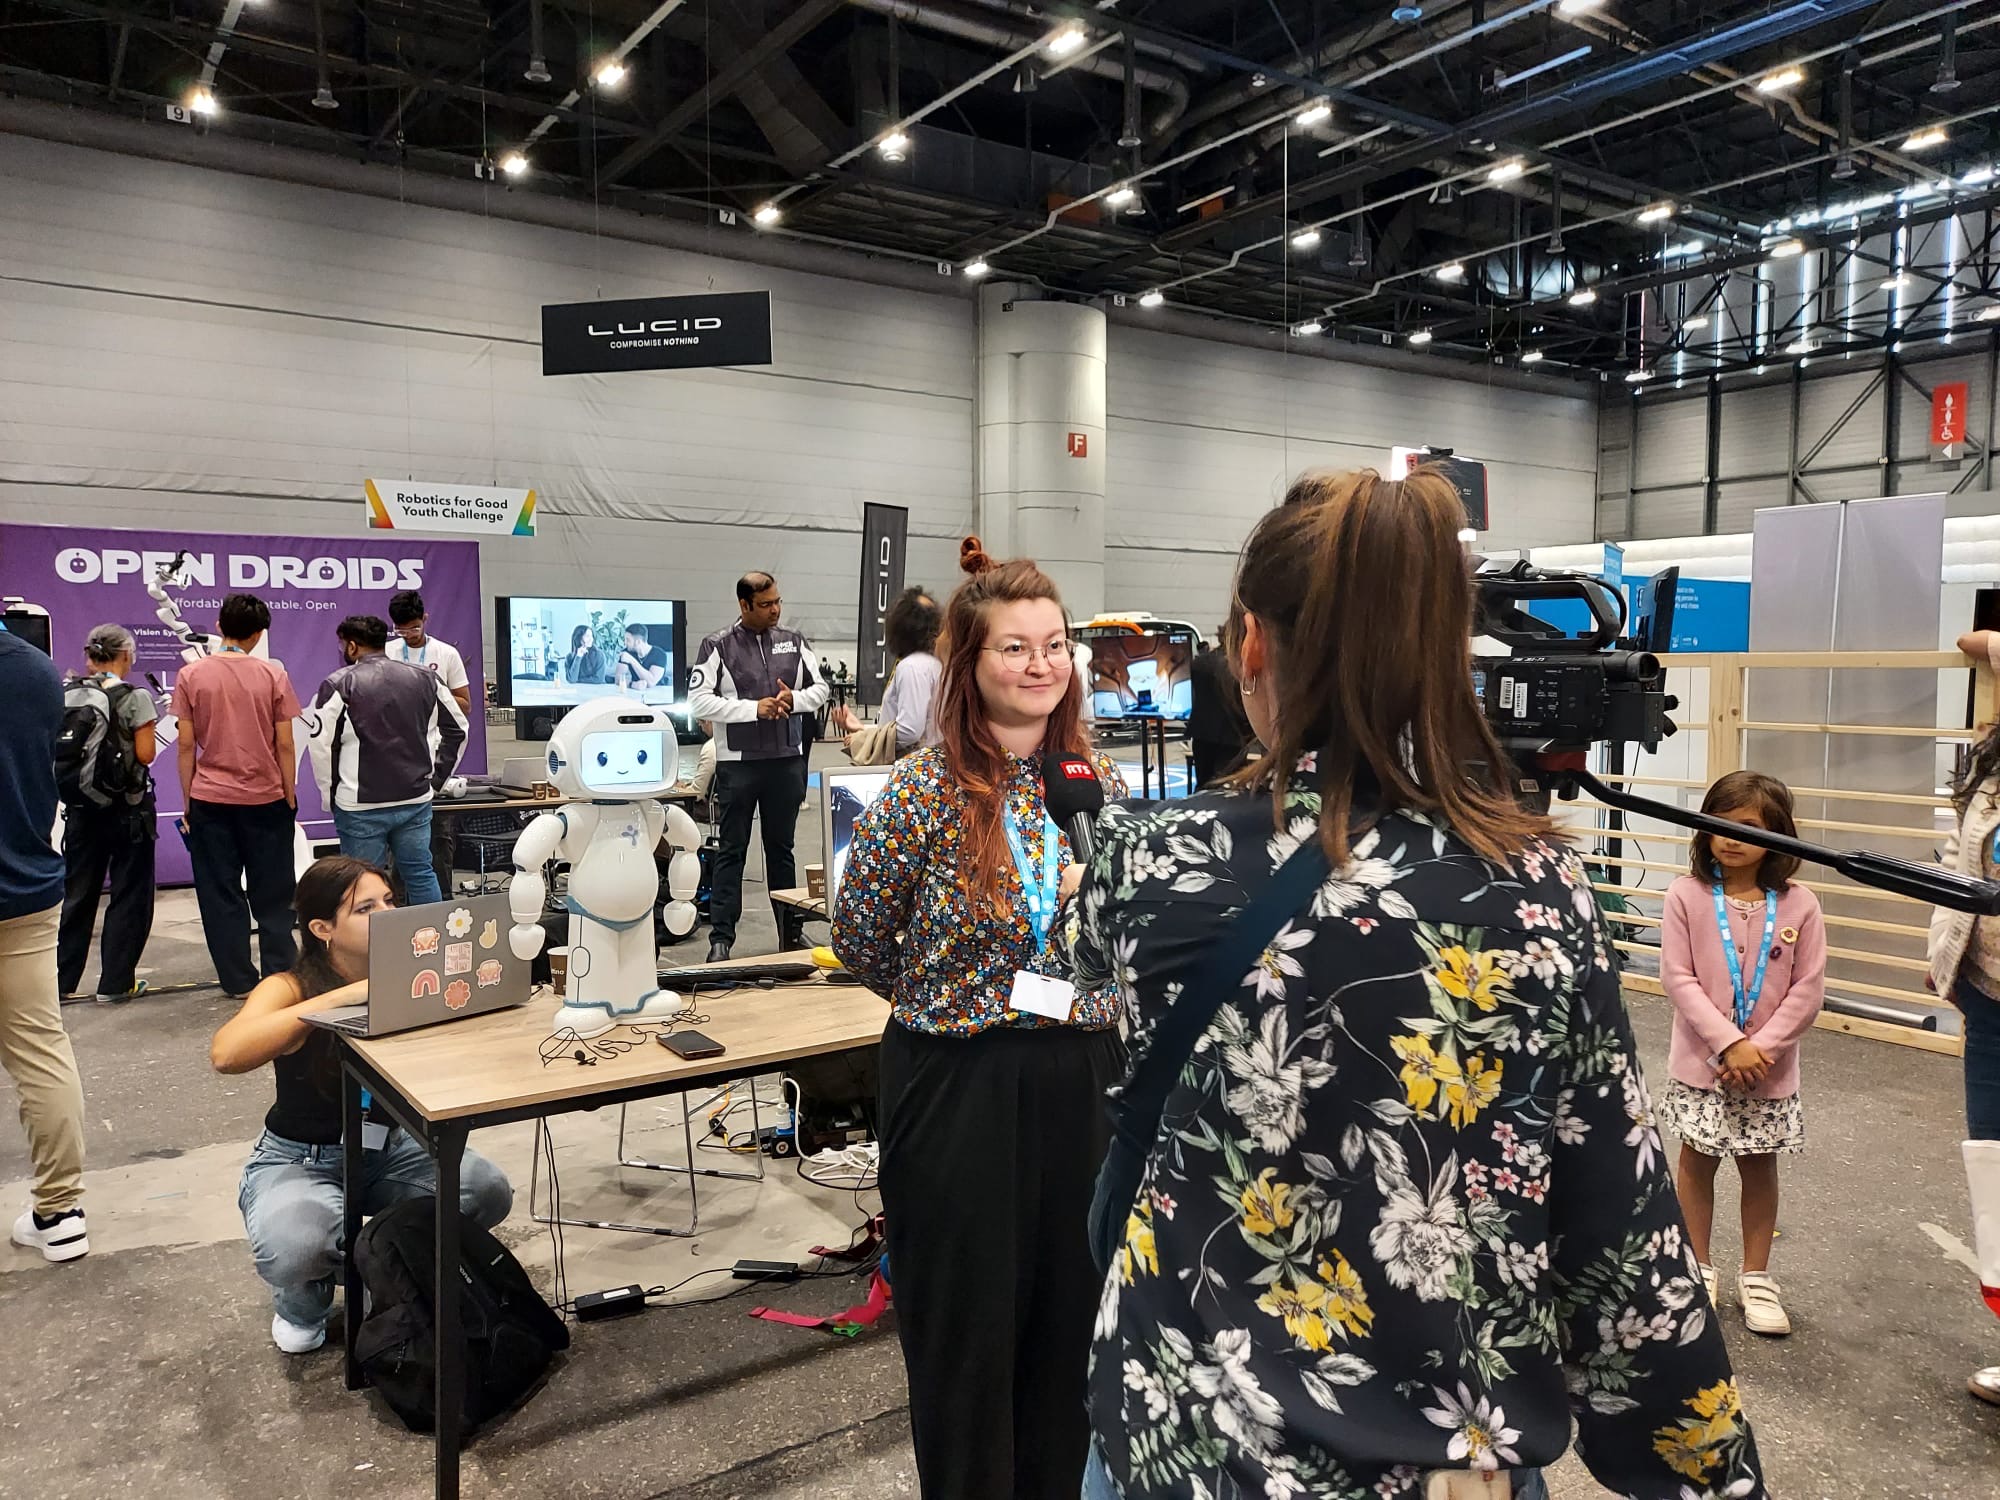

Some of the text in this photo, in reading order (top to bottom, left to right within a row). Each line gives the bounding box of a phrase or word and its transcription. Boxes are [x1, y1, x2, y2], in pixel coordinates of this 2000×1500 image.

[174, 106, 184, 120] 9
[724, 211, 731, 222] 7
[942, 263, 948, 274] 6
[587, 317, 722, 336] LUCID
[609, 336, 700, 350] COMPROMISE NOTHING
[1074, 434, 1084, 451] F
[397, 492, 509, 510] Robotics for Good
[402, 505, 504, 523] Youth Challenge
[55, 547, 425, 590] OPEN DROIDS
[305, 600, 337, 612] Open
[875, 536, 891, 679] LUCID
[1065, 764, 1091, 775] RTS
